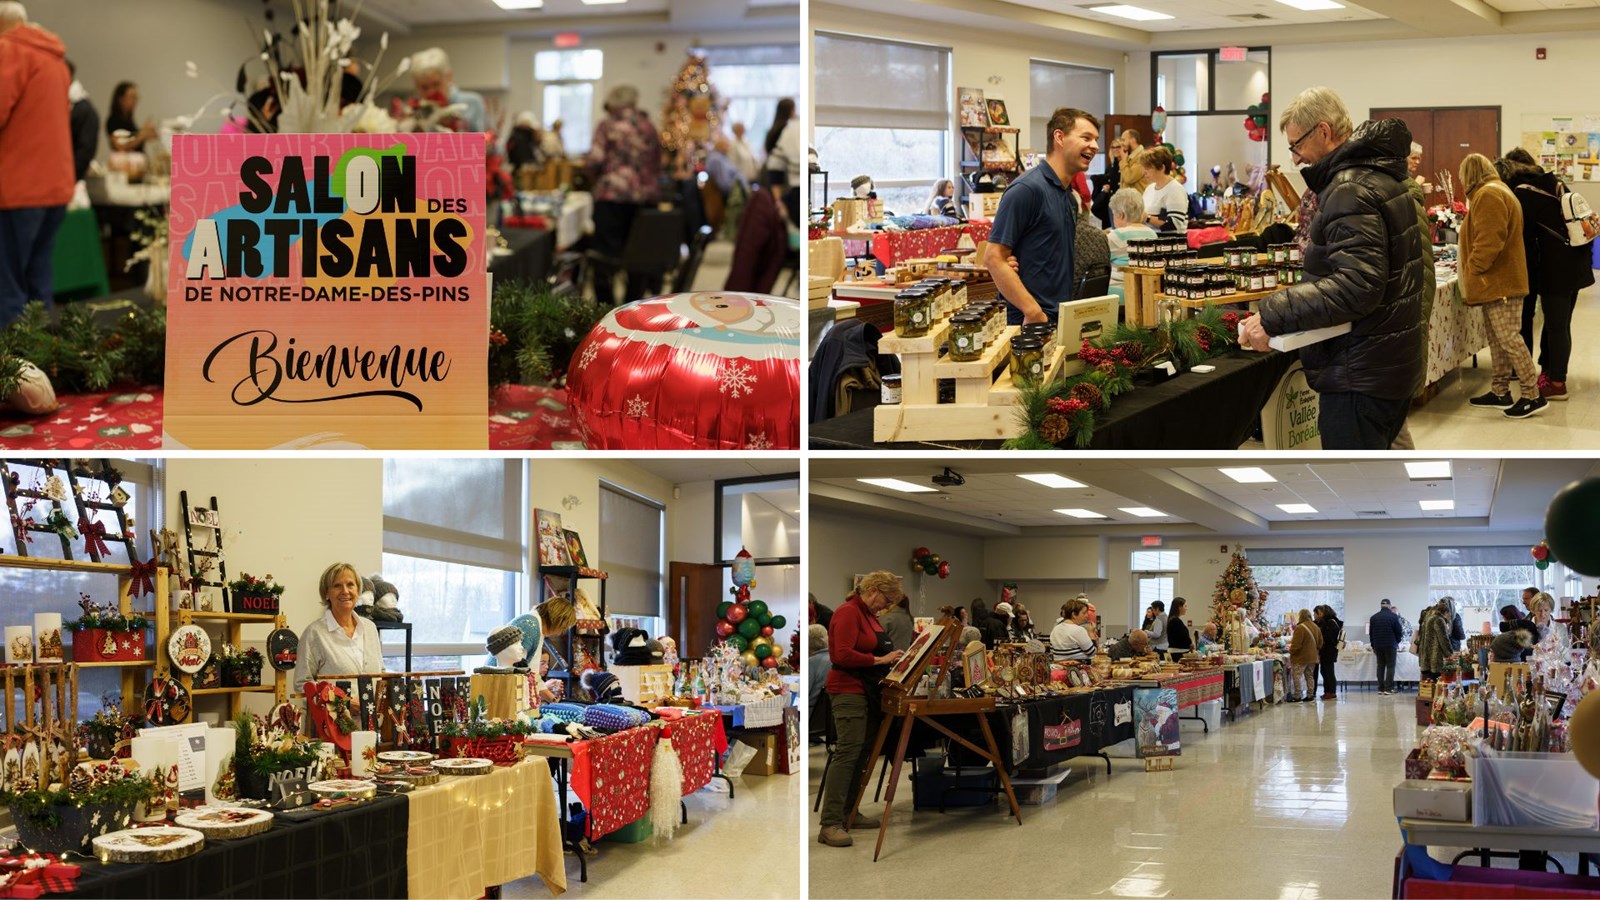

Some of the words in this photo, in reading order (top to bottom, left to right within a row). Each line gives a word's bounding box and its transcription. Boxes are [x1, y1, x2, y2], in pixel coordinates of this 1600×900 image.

[239, 155, 416, 215] SALON
[427, 198, 467, 213] DES
[186, 218, 468, 279] ARTISANS
[185, 286, 212, 301] DE
[220, 286, 470, 301] NOTRE-DAME-DES-PINS
[202, 329, 452, 412] Bienvenue
[1289, 404, 1317, 428] Vallée
[243, 597, 279, 609] NOEL
